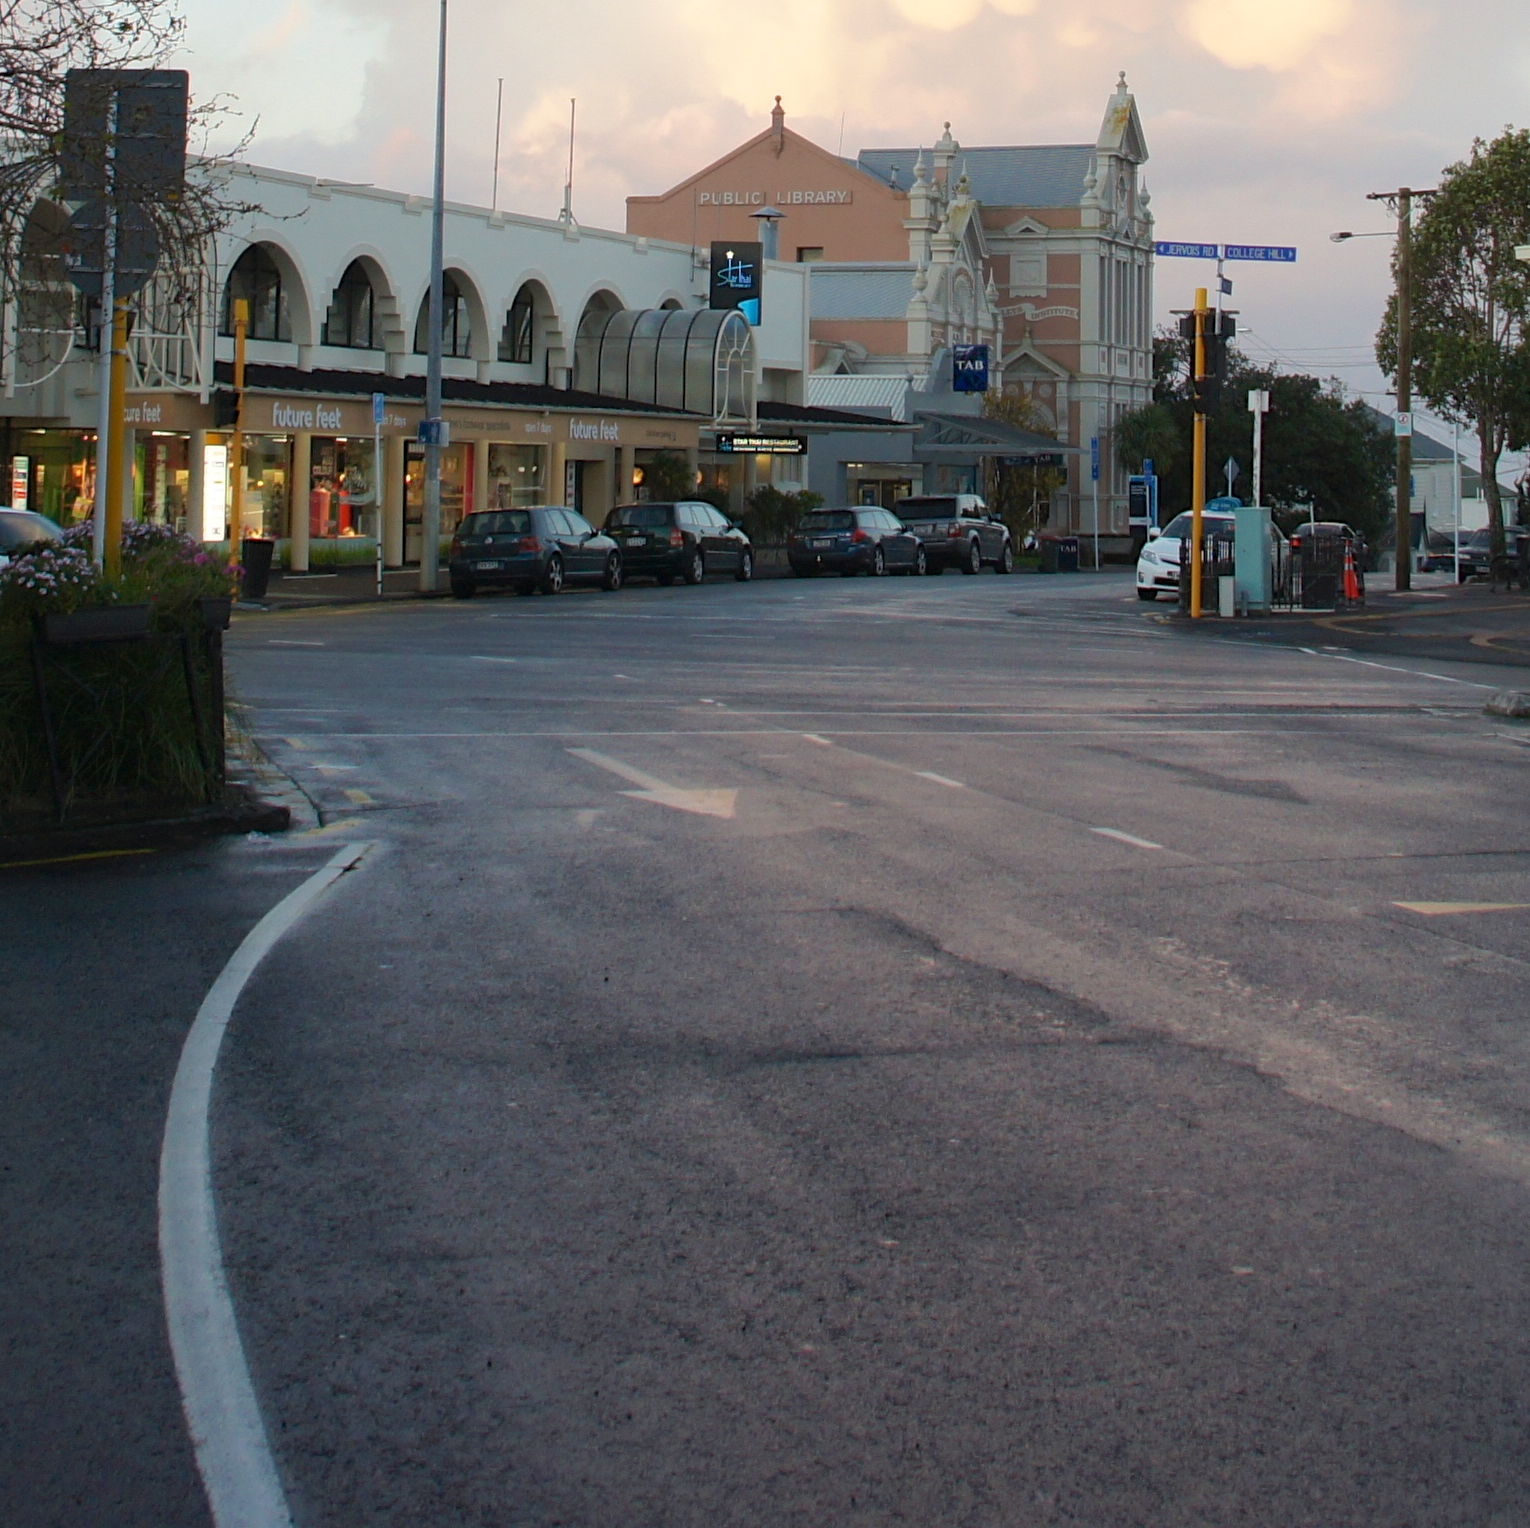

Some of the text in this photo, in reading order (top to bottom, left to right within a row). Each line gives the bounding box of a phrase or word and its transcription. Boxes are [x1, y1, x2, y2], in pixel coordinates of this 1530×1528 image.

[700, 190, 848, 205] PUBLIC LIBRARY
[1166, 244, 1286, 260] JERVOIS RD COLLEGE HILL
[955, 360, 984, 371] TAB
[273, 401, 342, 429] future feet
[569, 417, 619, 441] future feet
[1060, 544, 1077, 553] TAB
